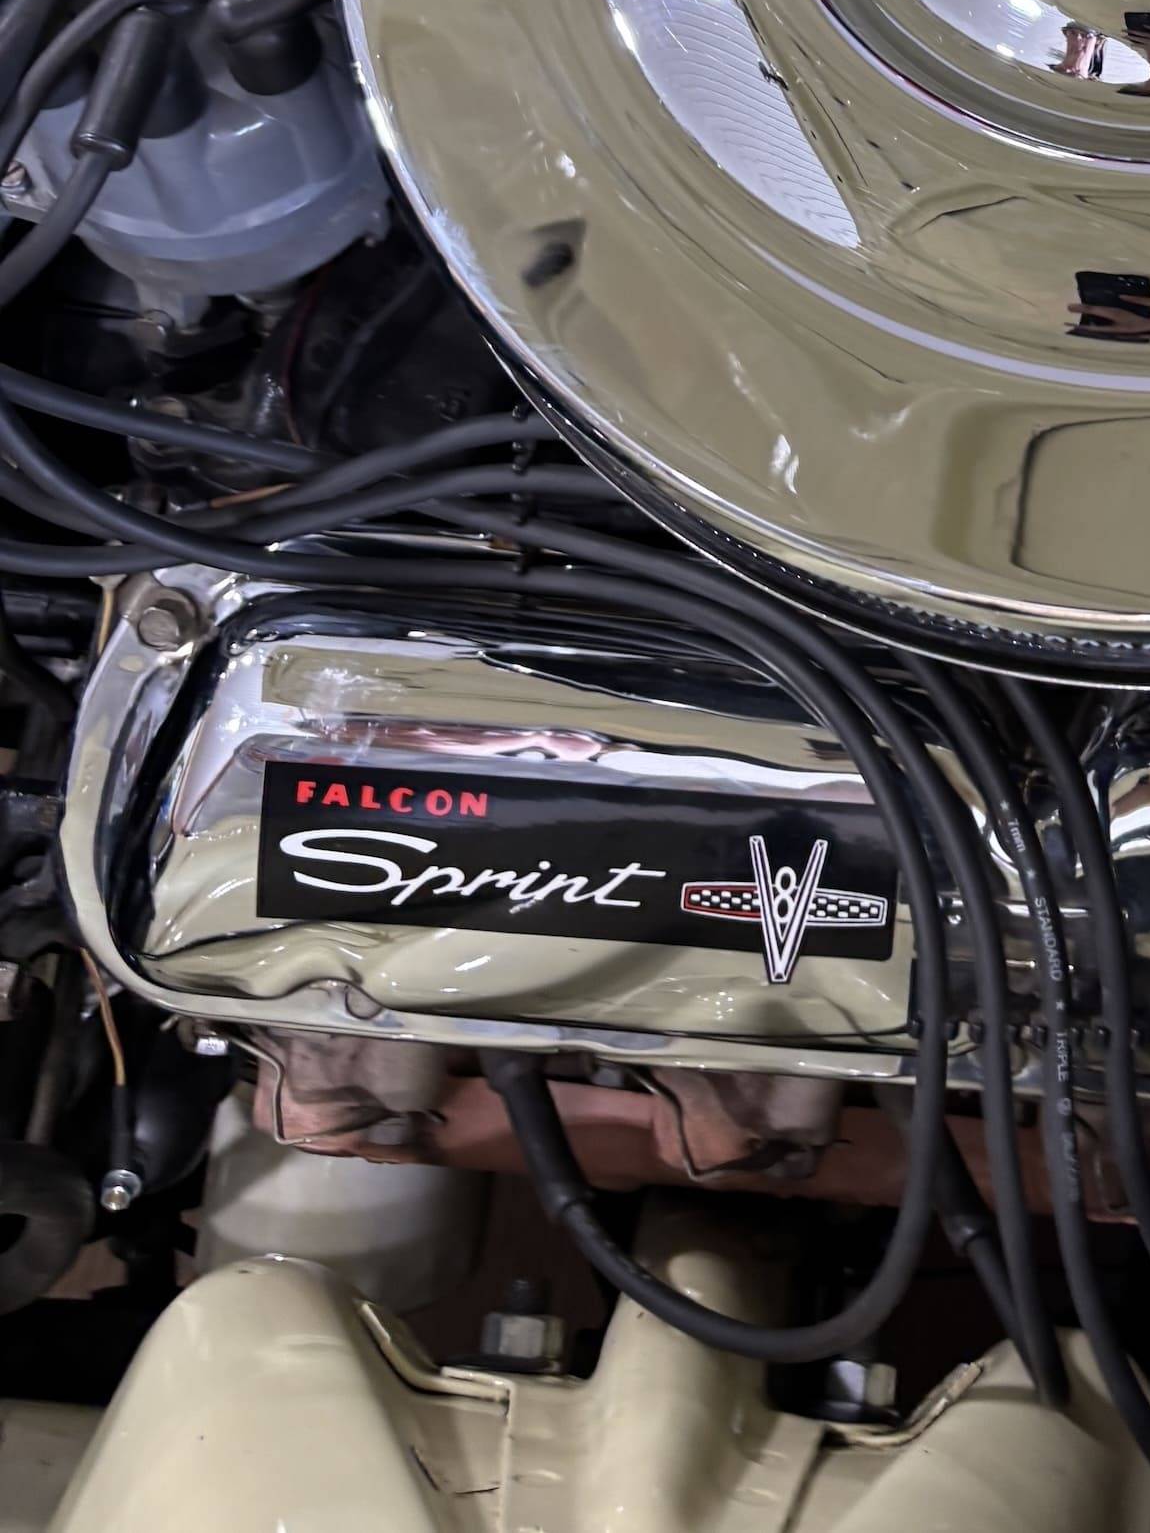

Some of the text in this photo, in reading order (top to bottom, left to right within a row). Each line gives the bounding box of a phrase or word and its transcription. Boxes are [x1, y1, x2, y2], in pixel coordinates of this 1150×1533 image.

[296, 780, 489, 818] FALCON
[279, 828, 667, 907] Sprint
[1007, 817, 1026, 852] 7mm
[1034, 897, 1063, 982] STANDARD
